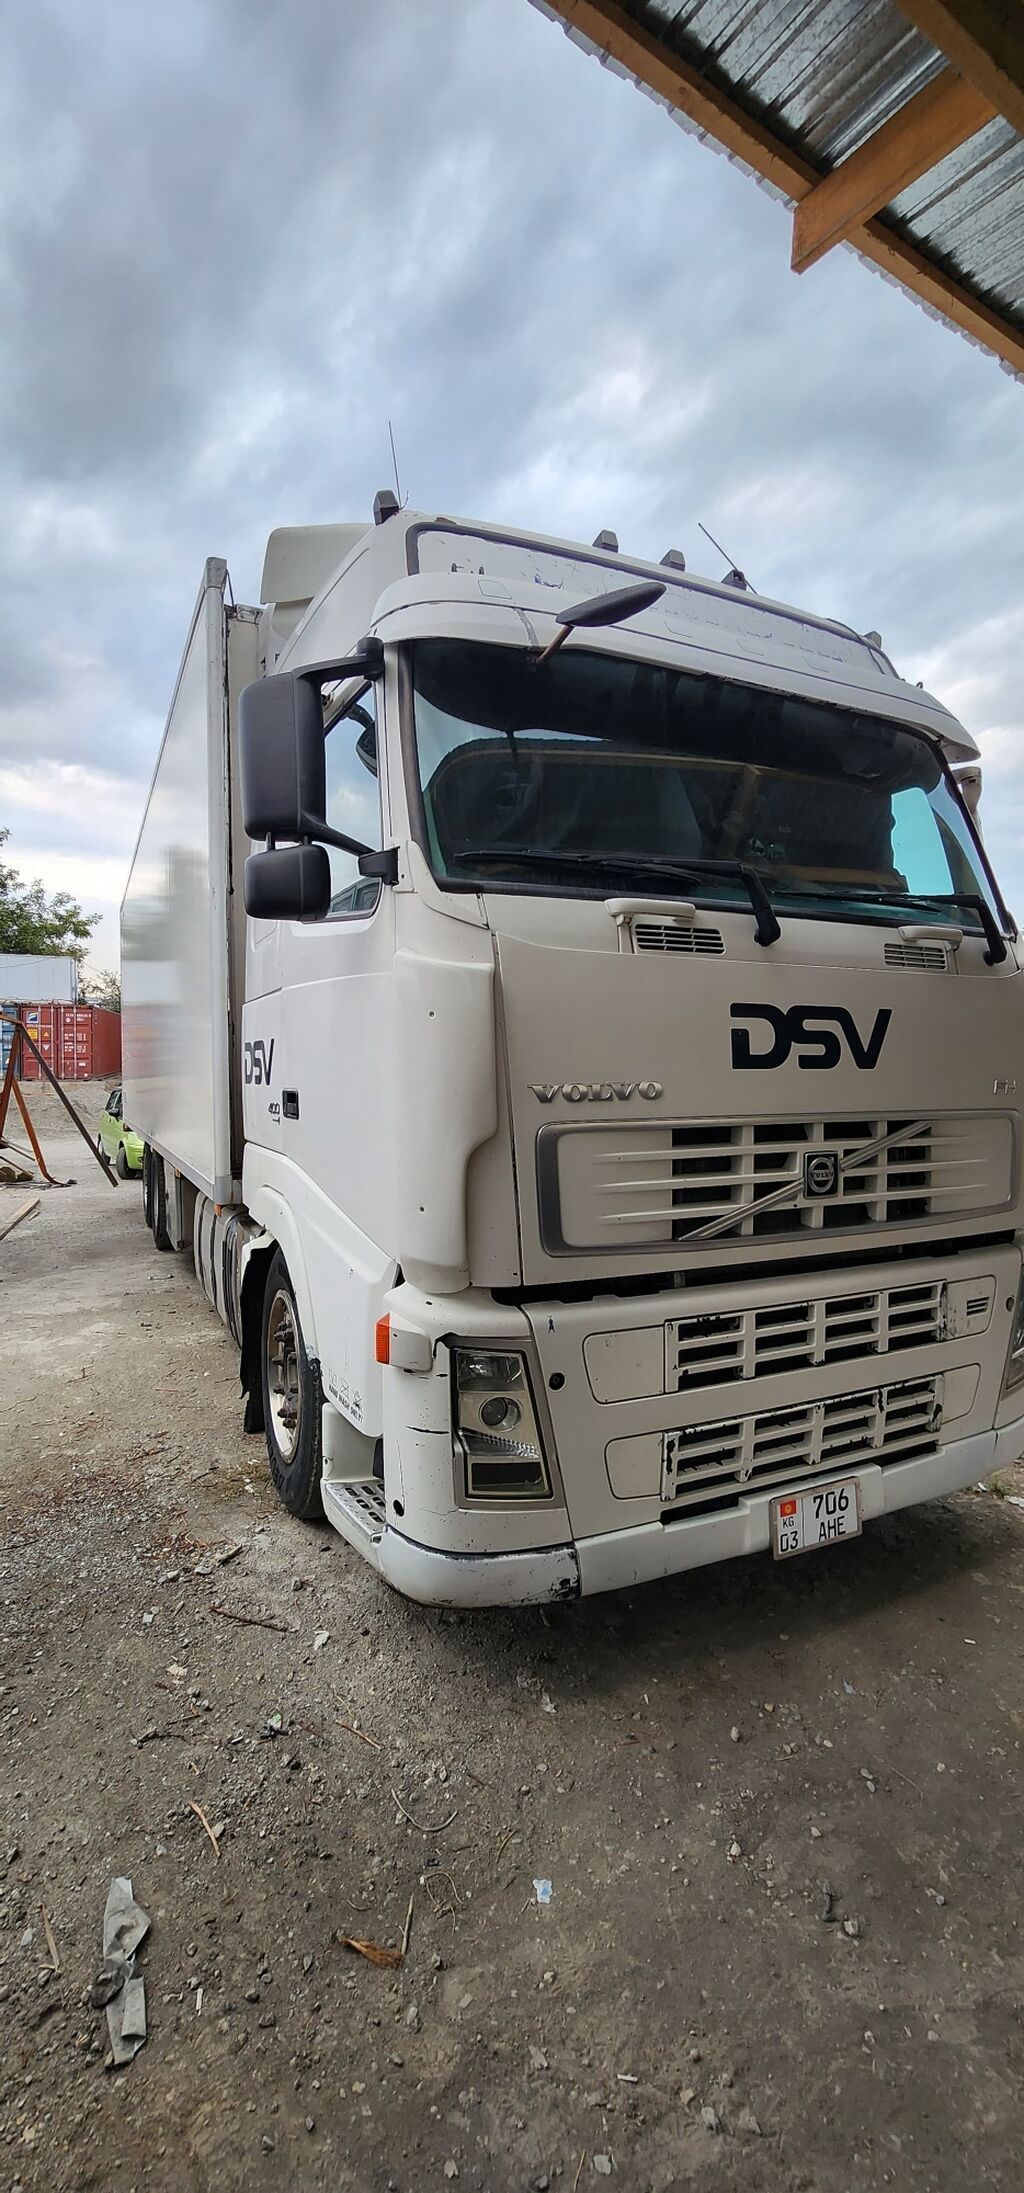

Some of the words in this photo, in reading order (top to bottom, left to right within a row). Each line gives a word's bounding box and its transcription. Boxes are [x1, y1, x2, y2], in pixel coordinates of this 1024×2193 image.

[730, 1002, 892, 1070] DSV
[245, 1038, 275, 1086] DSV
[526, 1080, 664, 1103] VOLVO
[809, 1170, 834, 1178] VOLVO
[813, 1488, 849, 1519] 706
[783, 1516, 795, 1529] KG
[818, 1515, 846, 1542] AHE
[780, 1531, 799, 1552] 03
